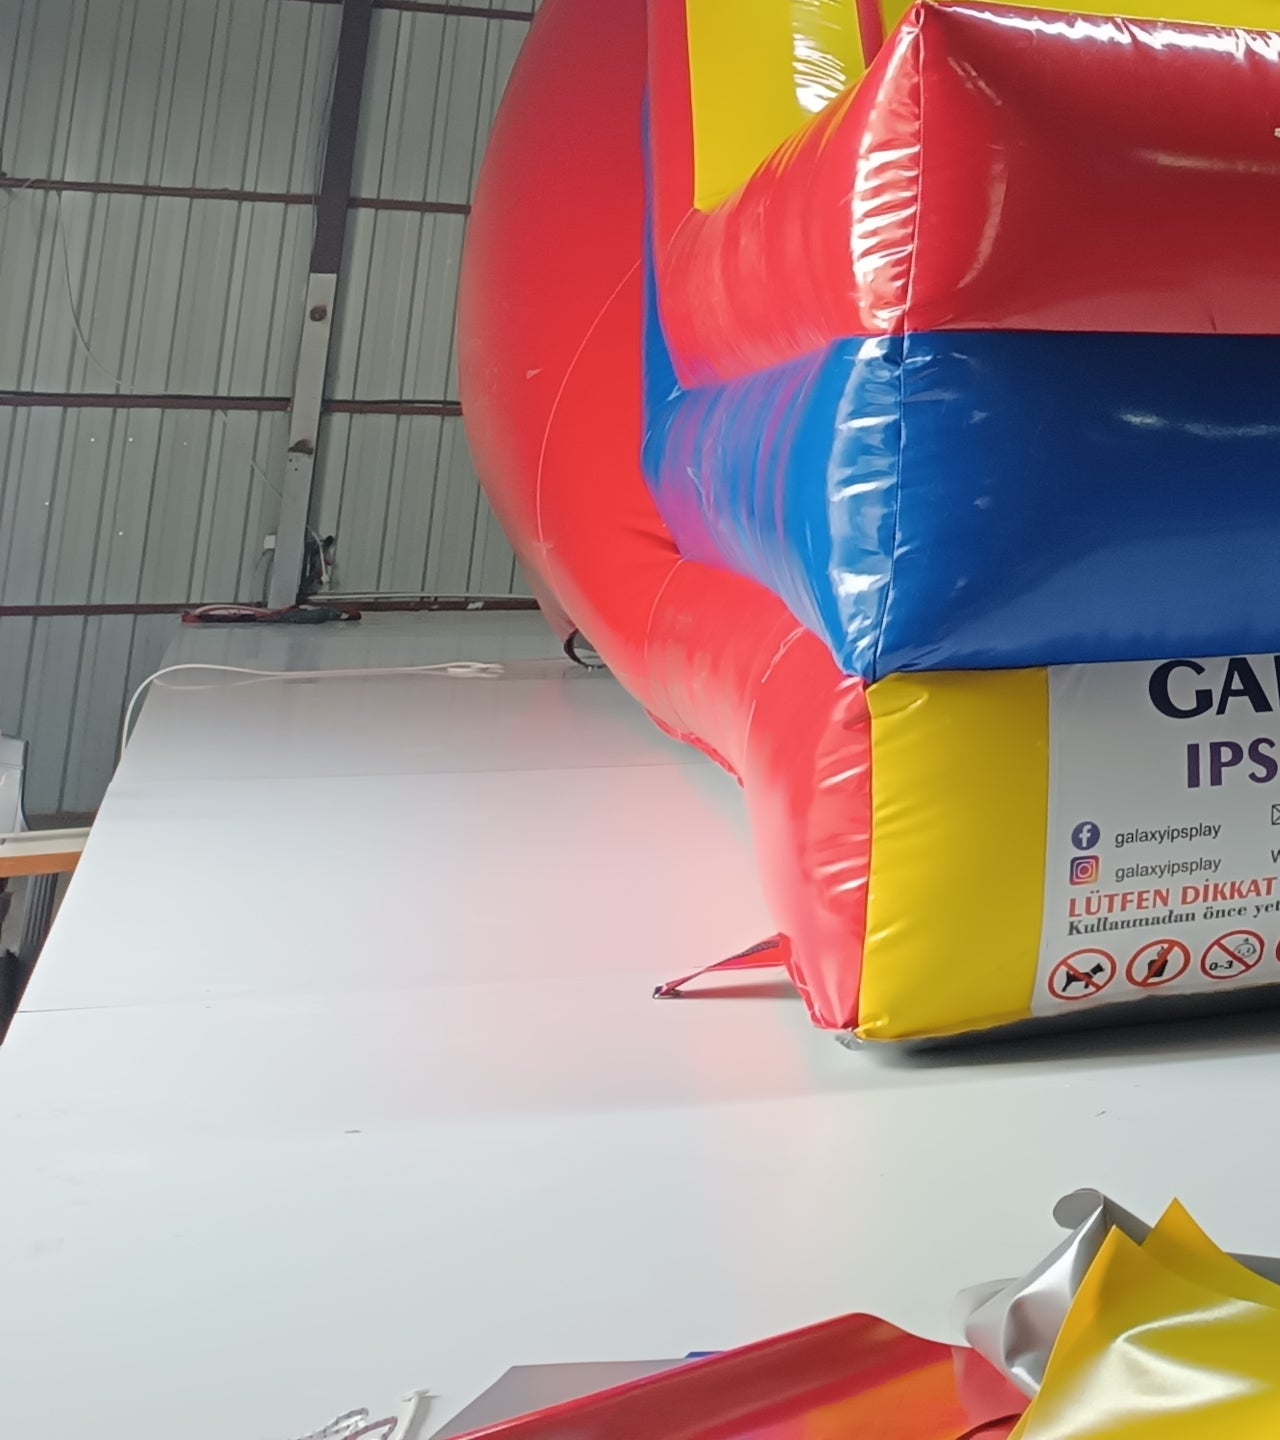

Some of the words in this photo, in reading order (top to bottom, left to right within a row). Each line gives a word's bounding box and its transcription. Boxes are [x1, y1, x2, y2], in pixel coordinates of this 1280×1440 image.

[1187, 737, 1279, 789] IPS
[1114, 822, 1222, 848] galaxyipsplay
[1114, 857, 1222, 883] galaxyipsplay
[1068, 887, 1171, 918] LÜTFEN
[1180, 877, 1278, 906] DİKKAT
[1066, 910, 1197, 937] Kullanmadan
[1203, 905, 1248, 921] önce
[1208, 959, 1234, 971] 0-3
